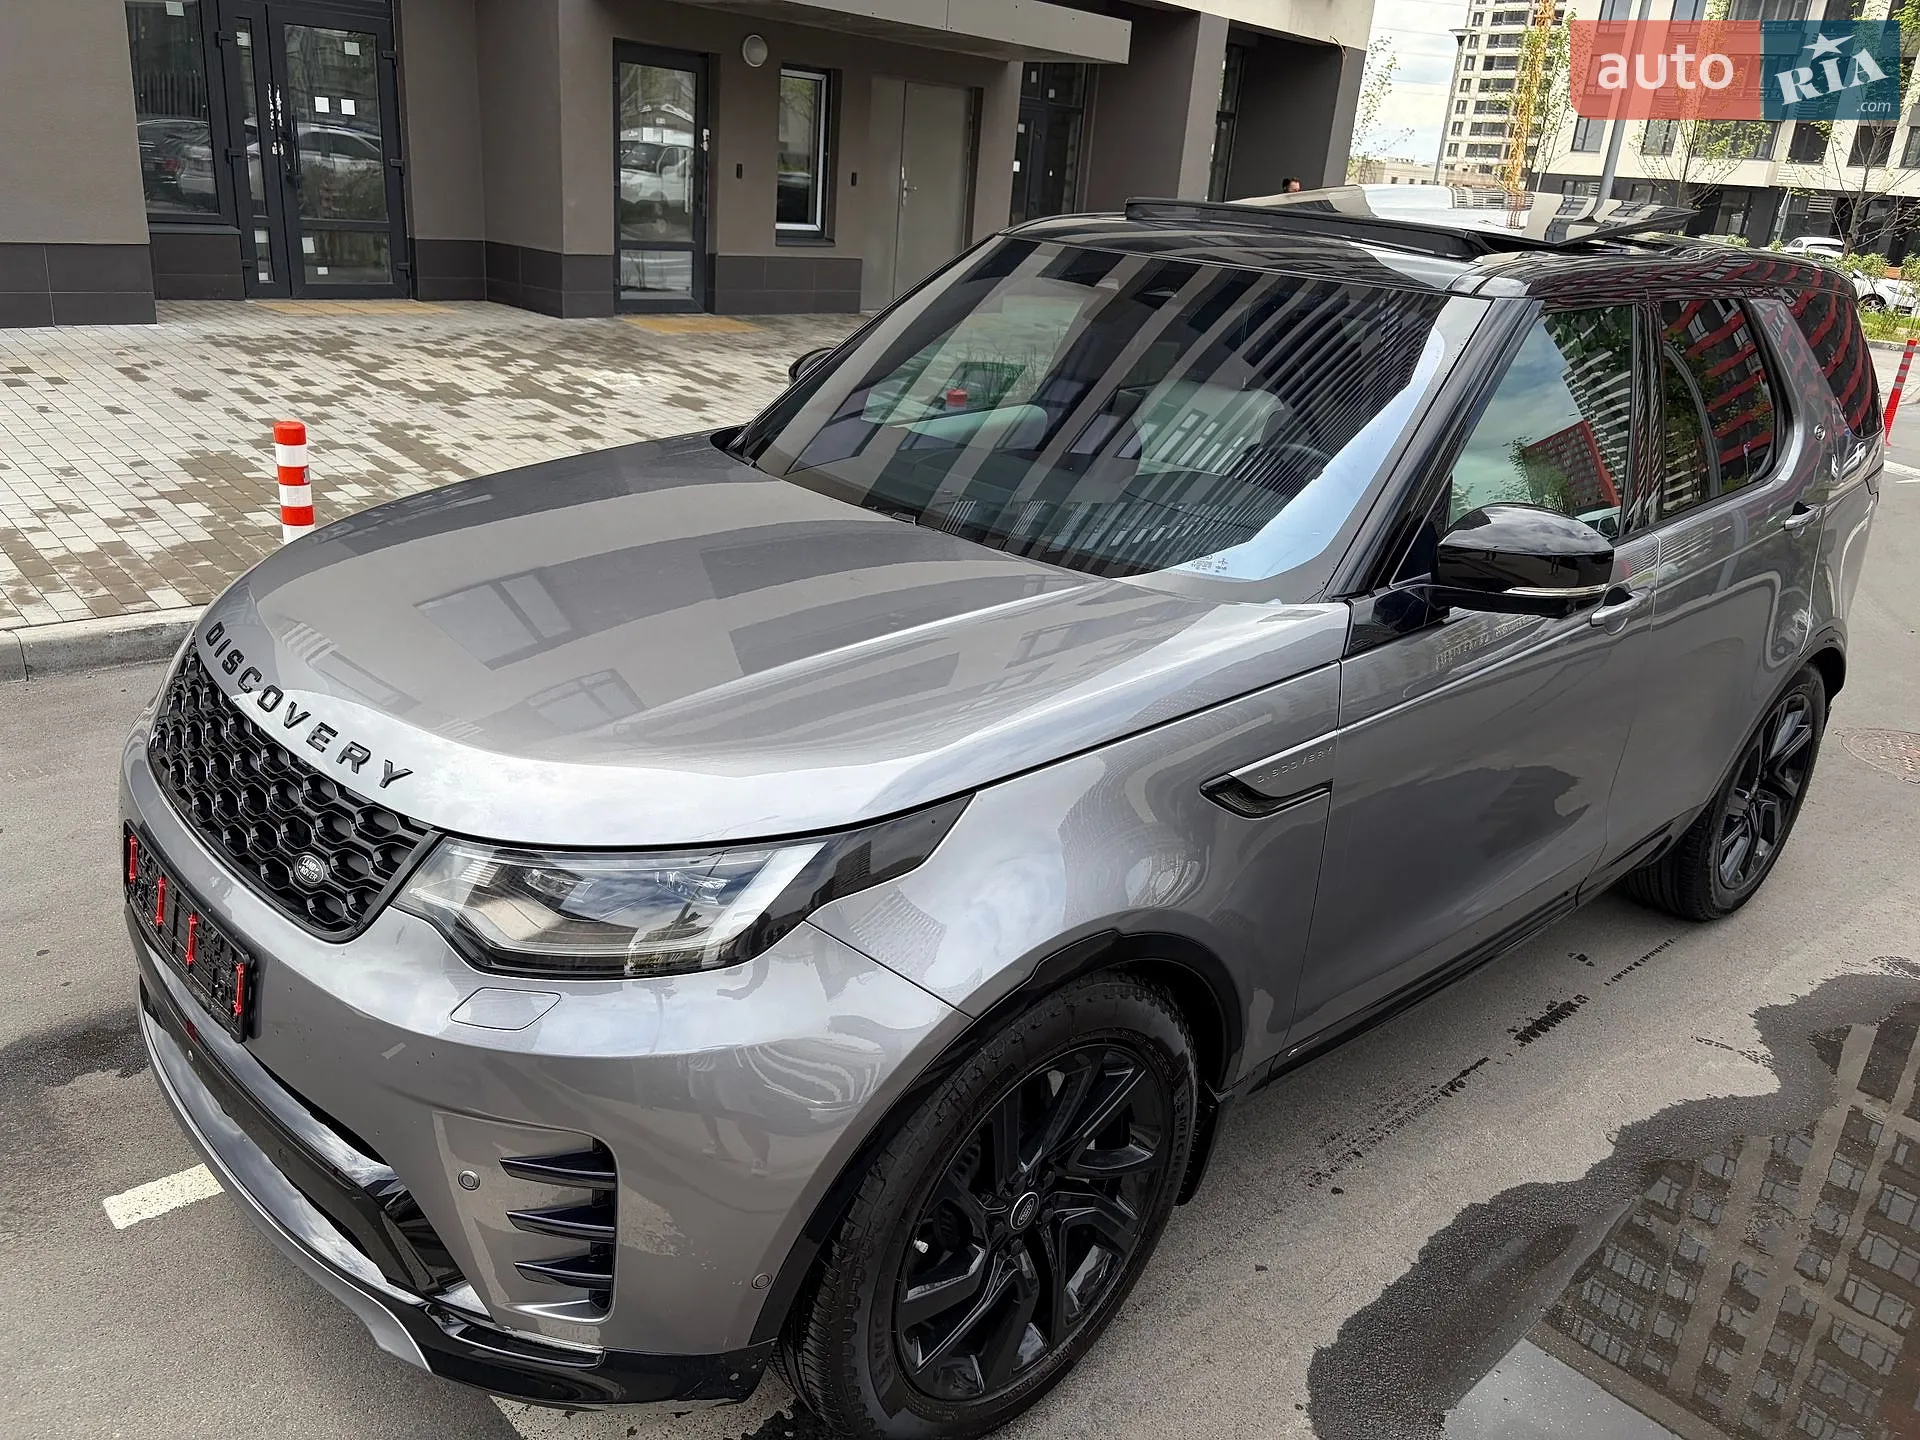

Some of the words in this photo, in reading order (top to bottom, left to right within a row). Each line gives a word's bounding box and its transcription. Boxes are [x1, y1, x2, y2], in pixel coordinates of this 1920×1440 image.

[205, 621, 413, 789] DISCOVERY
[301, 858, 317, 871] LAND
[299, 865, 318, 881] ROVER
